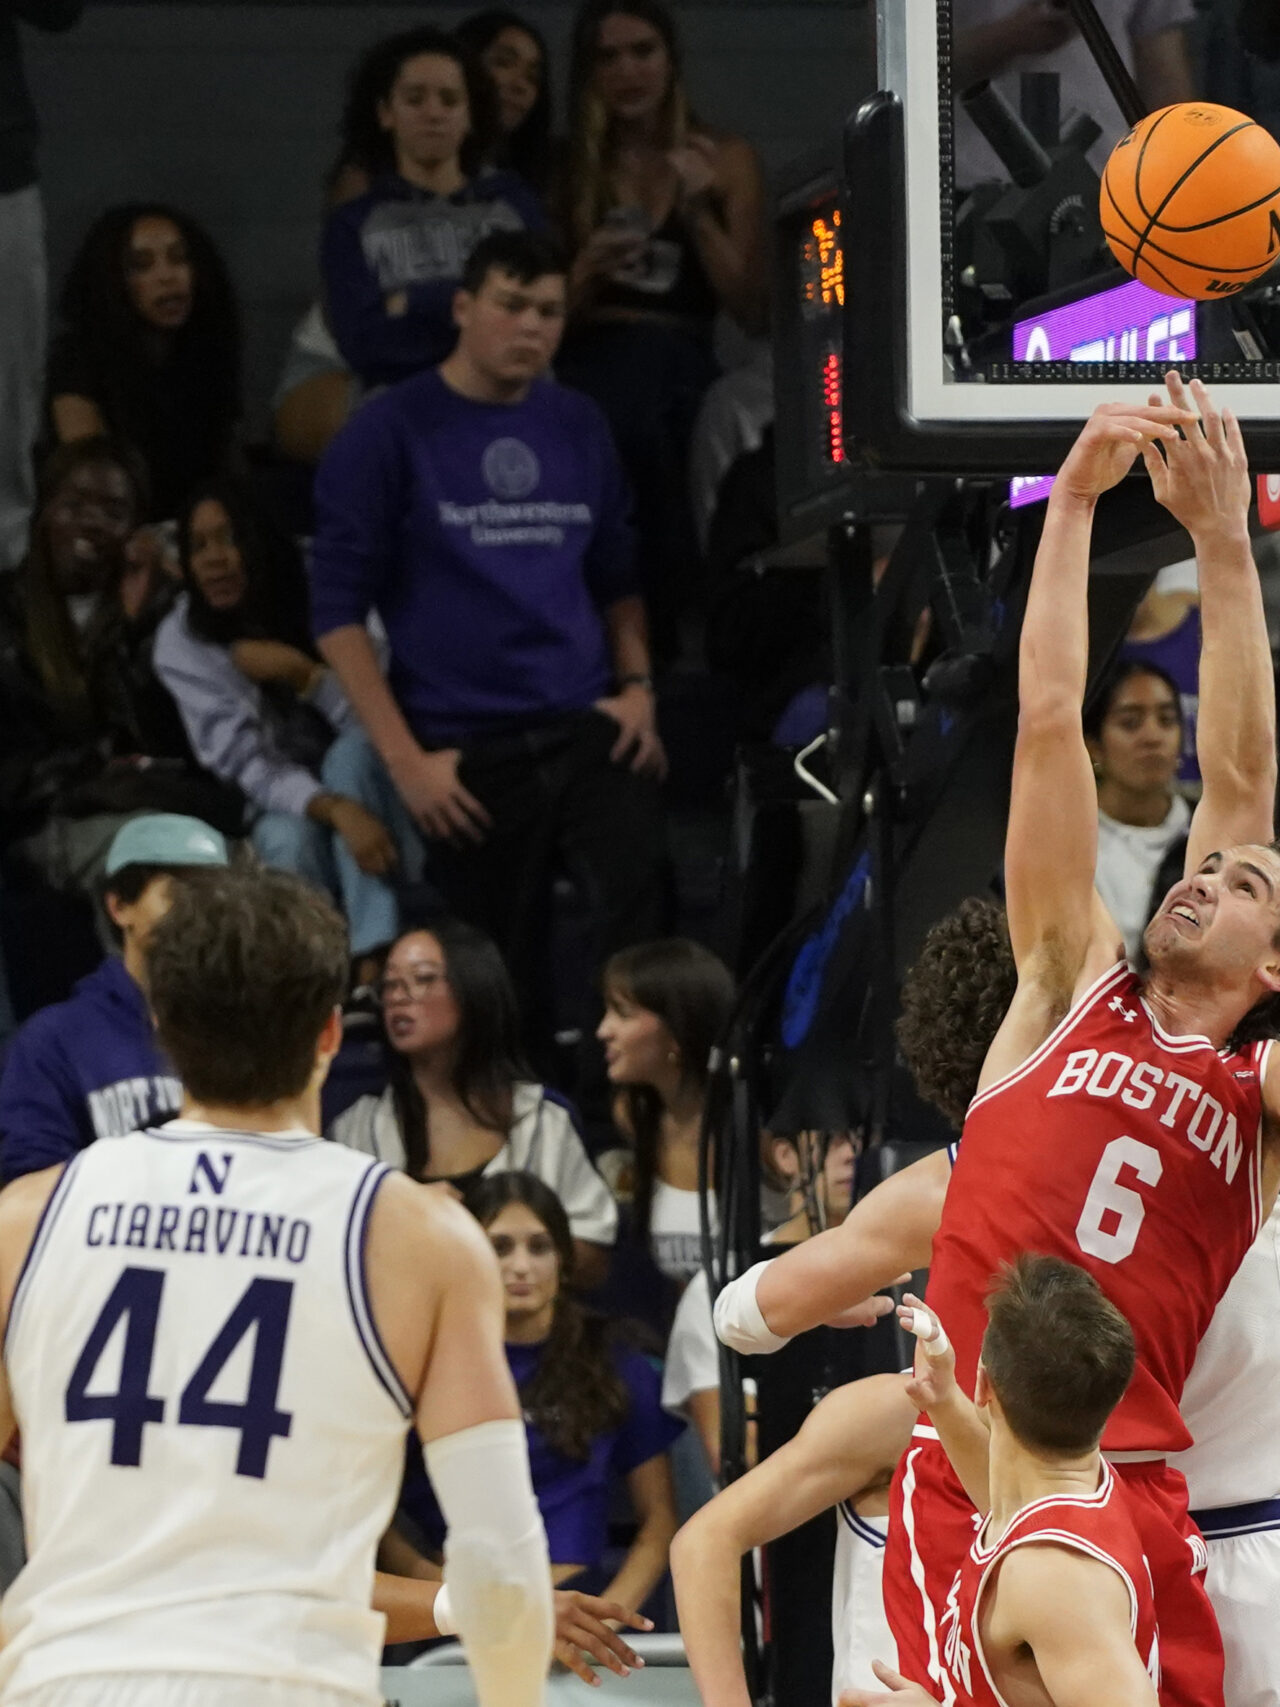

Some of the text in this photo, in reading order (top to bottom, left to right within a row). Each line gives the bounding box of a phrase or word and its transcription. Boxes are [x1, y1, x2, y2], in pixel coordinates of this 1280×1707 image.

[188, 1152, 234, 1194] N
[1046, 1048, 1244, 1186] BOSTON
[87, 1203, 311, 1263] CIARAVINO
[1075, 1135, 1164, 1265] 6
[65, 1265, 295, 1480] 44
